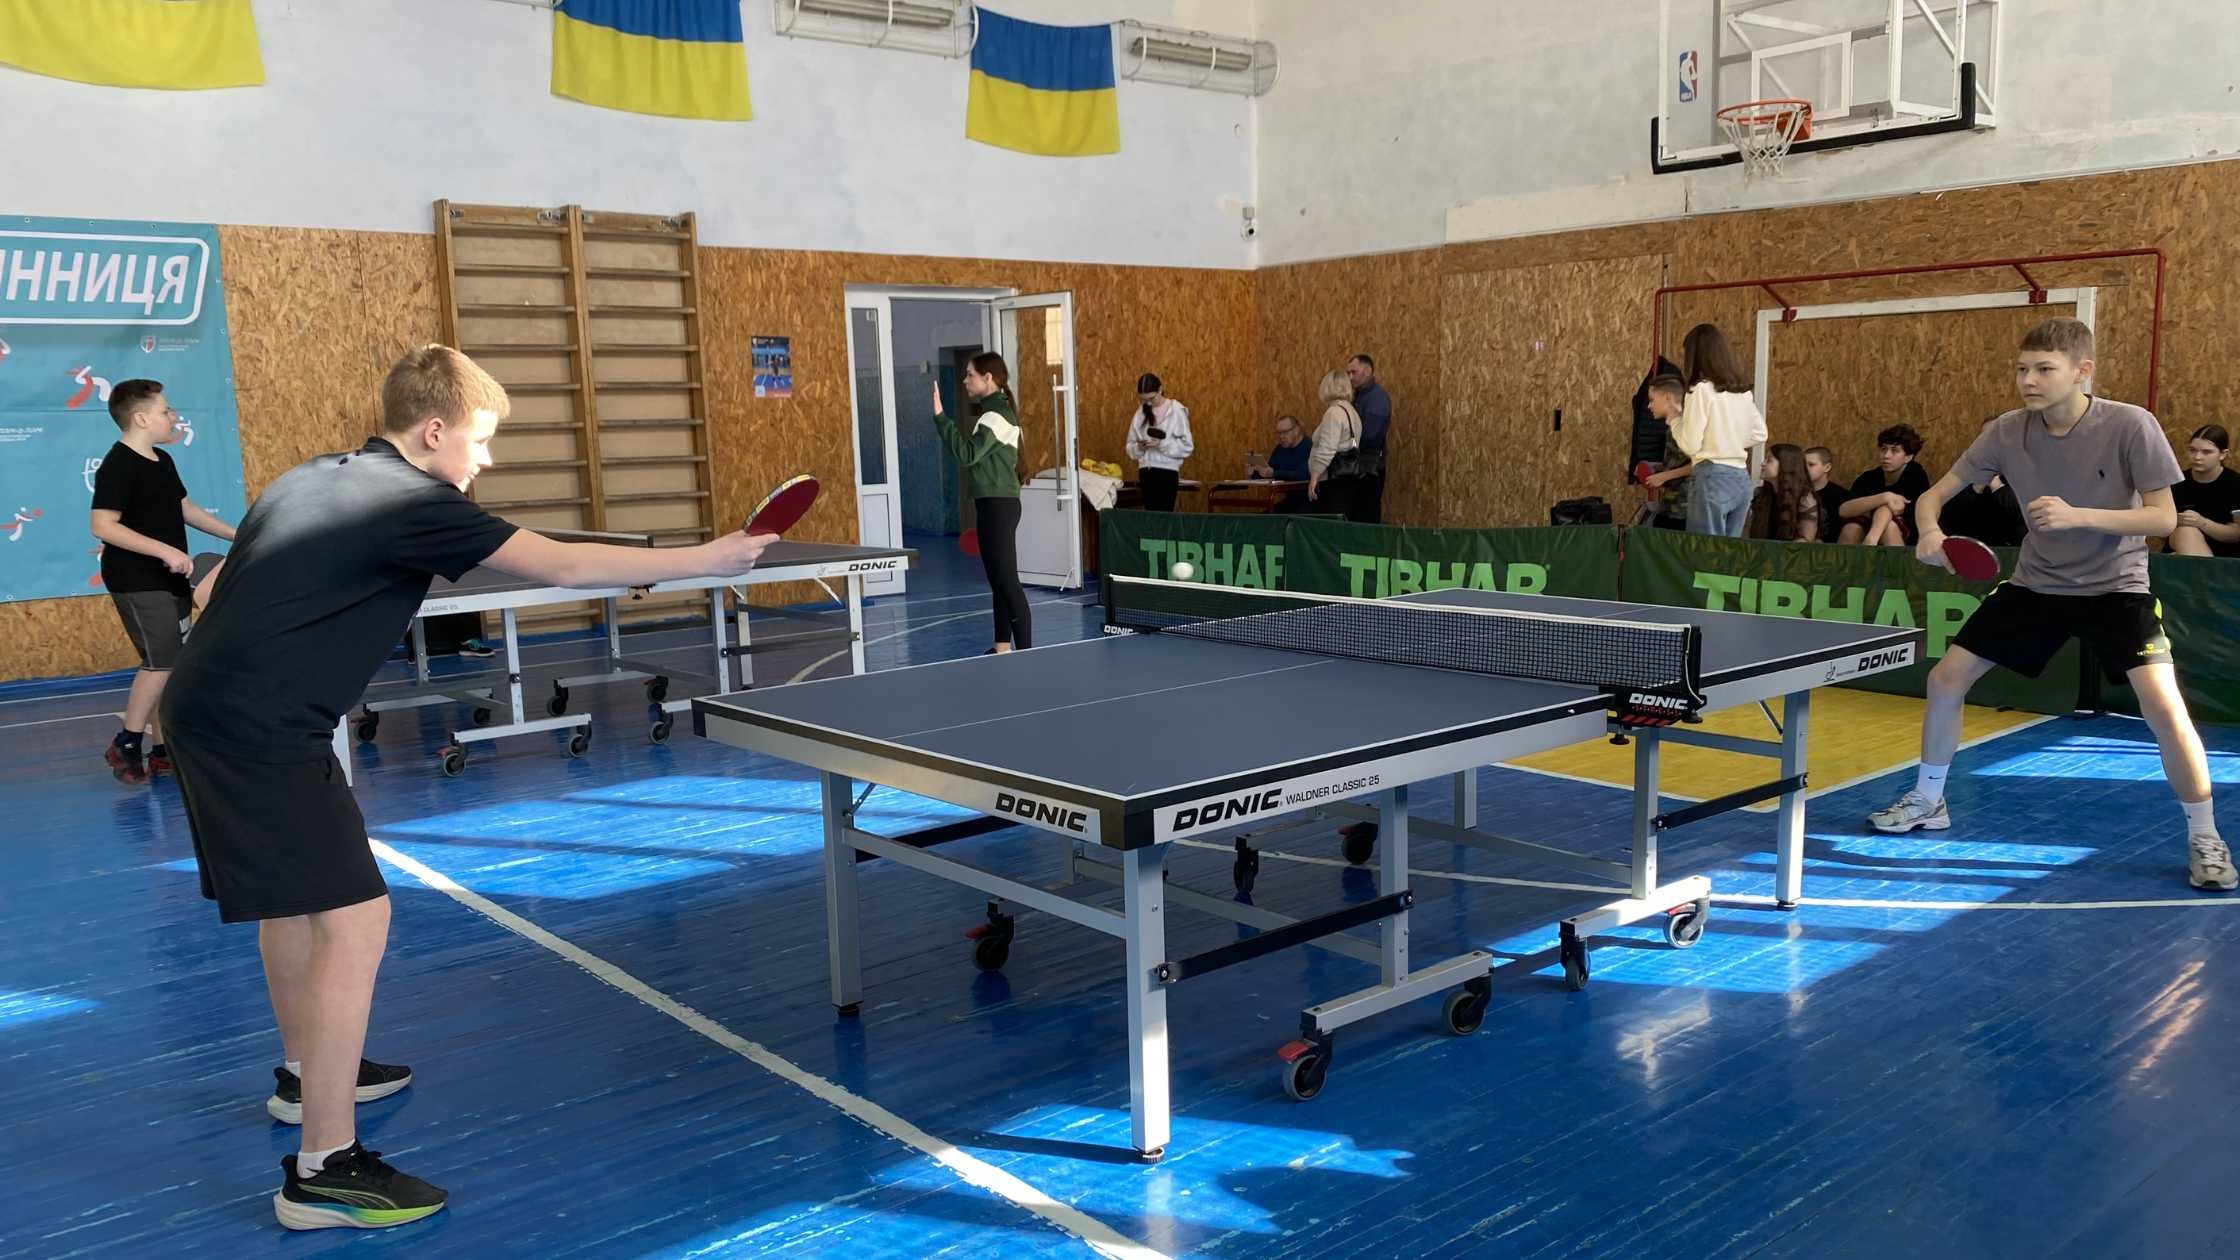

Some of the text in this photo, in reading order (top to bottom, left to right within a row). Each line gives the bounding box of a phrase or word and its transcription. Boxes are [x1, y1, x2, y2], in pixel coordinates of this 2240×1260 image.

[0, 249, 190, 316] ННИЦЯ
[848, 560, 897, 572] DONIC
[1104, 625, 1134, 636] DONIC
[1857, 647, 1909, 672] DONIC
[1628, 692, 1689, 710] DONIC
[995, 792, 1088, 833] DONIC
[1172, 774, 1380, 833] DONIC WALDNER CLASSIC 25
